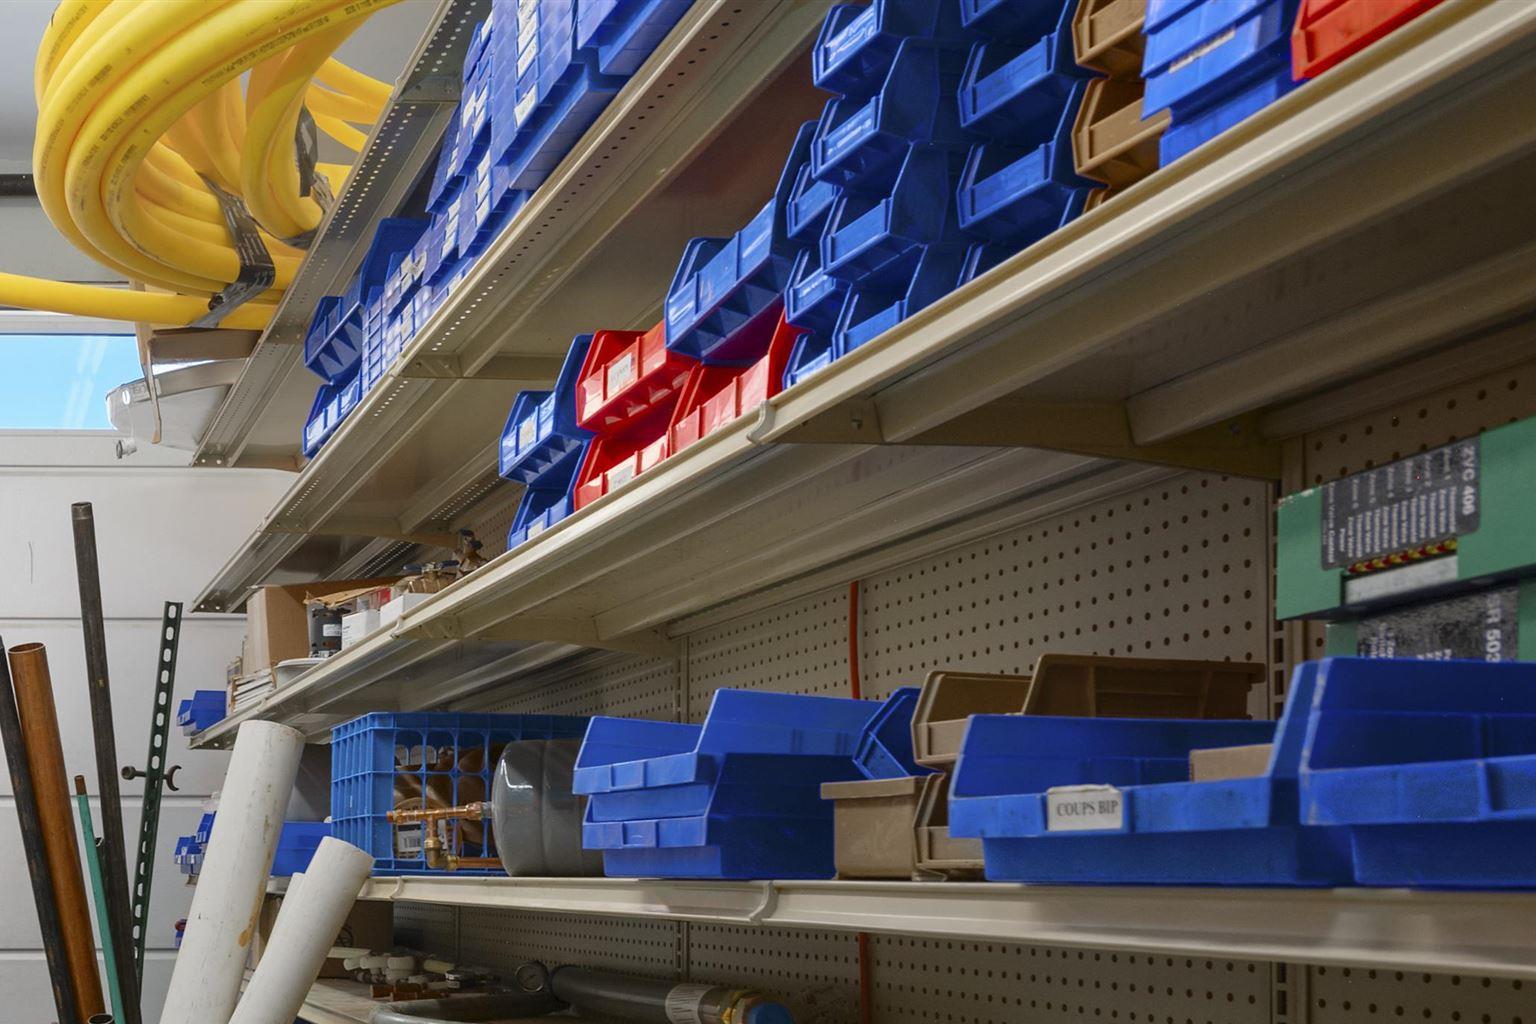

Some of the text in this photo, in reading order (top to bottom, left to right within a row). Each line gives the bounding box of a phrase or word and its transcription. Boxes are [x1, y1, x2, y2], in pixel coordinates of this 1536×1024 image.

[1461, 446, 1476, 516] ZVC 406
[1327, 530, 1336, 563] Control
[1486, 593, 1501, 623] SR
[1098, 799, 1120, 815] BIP
